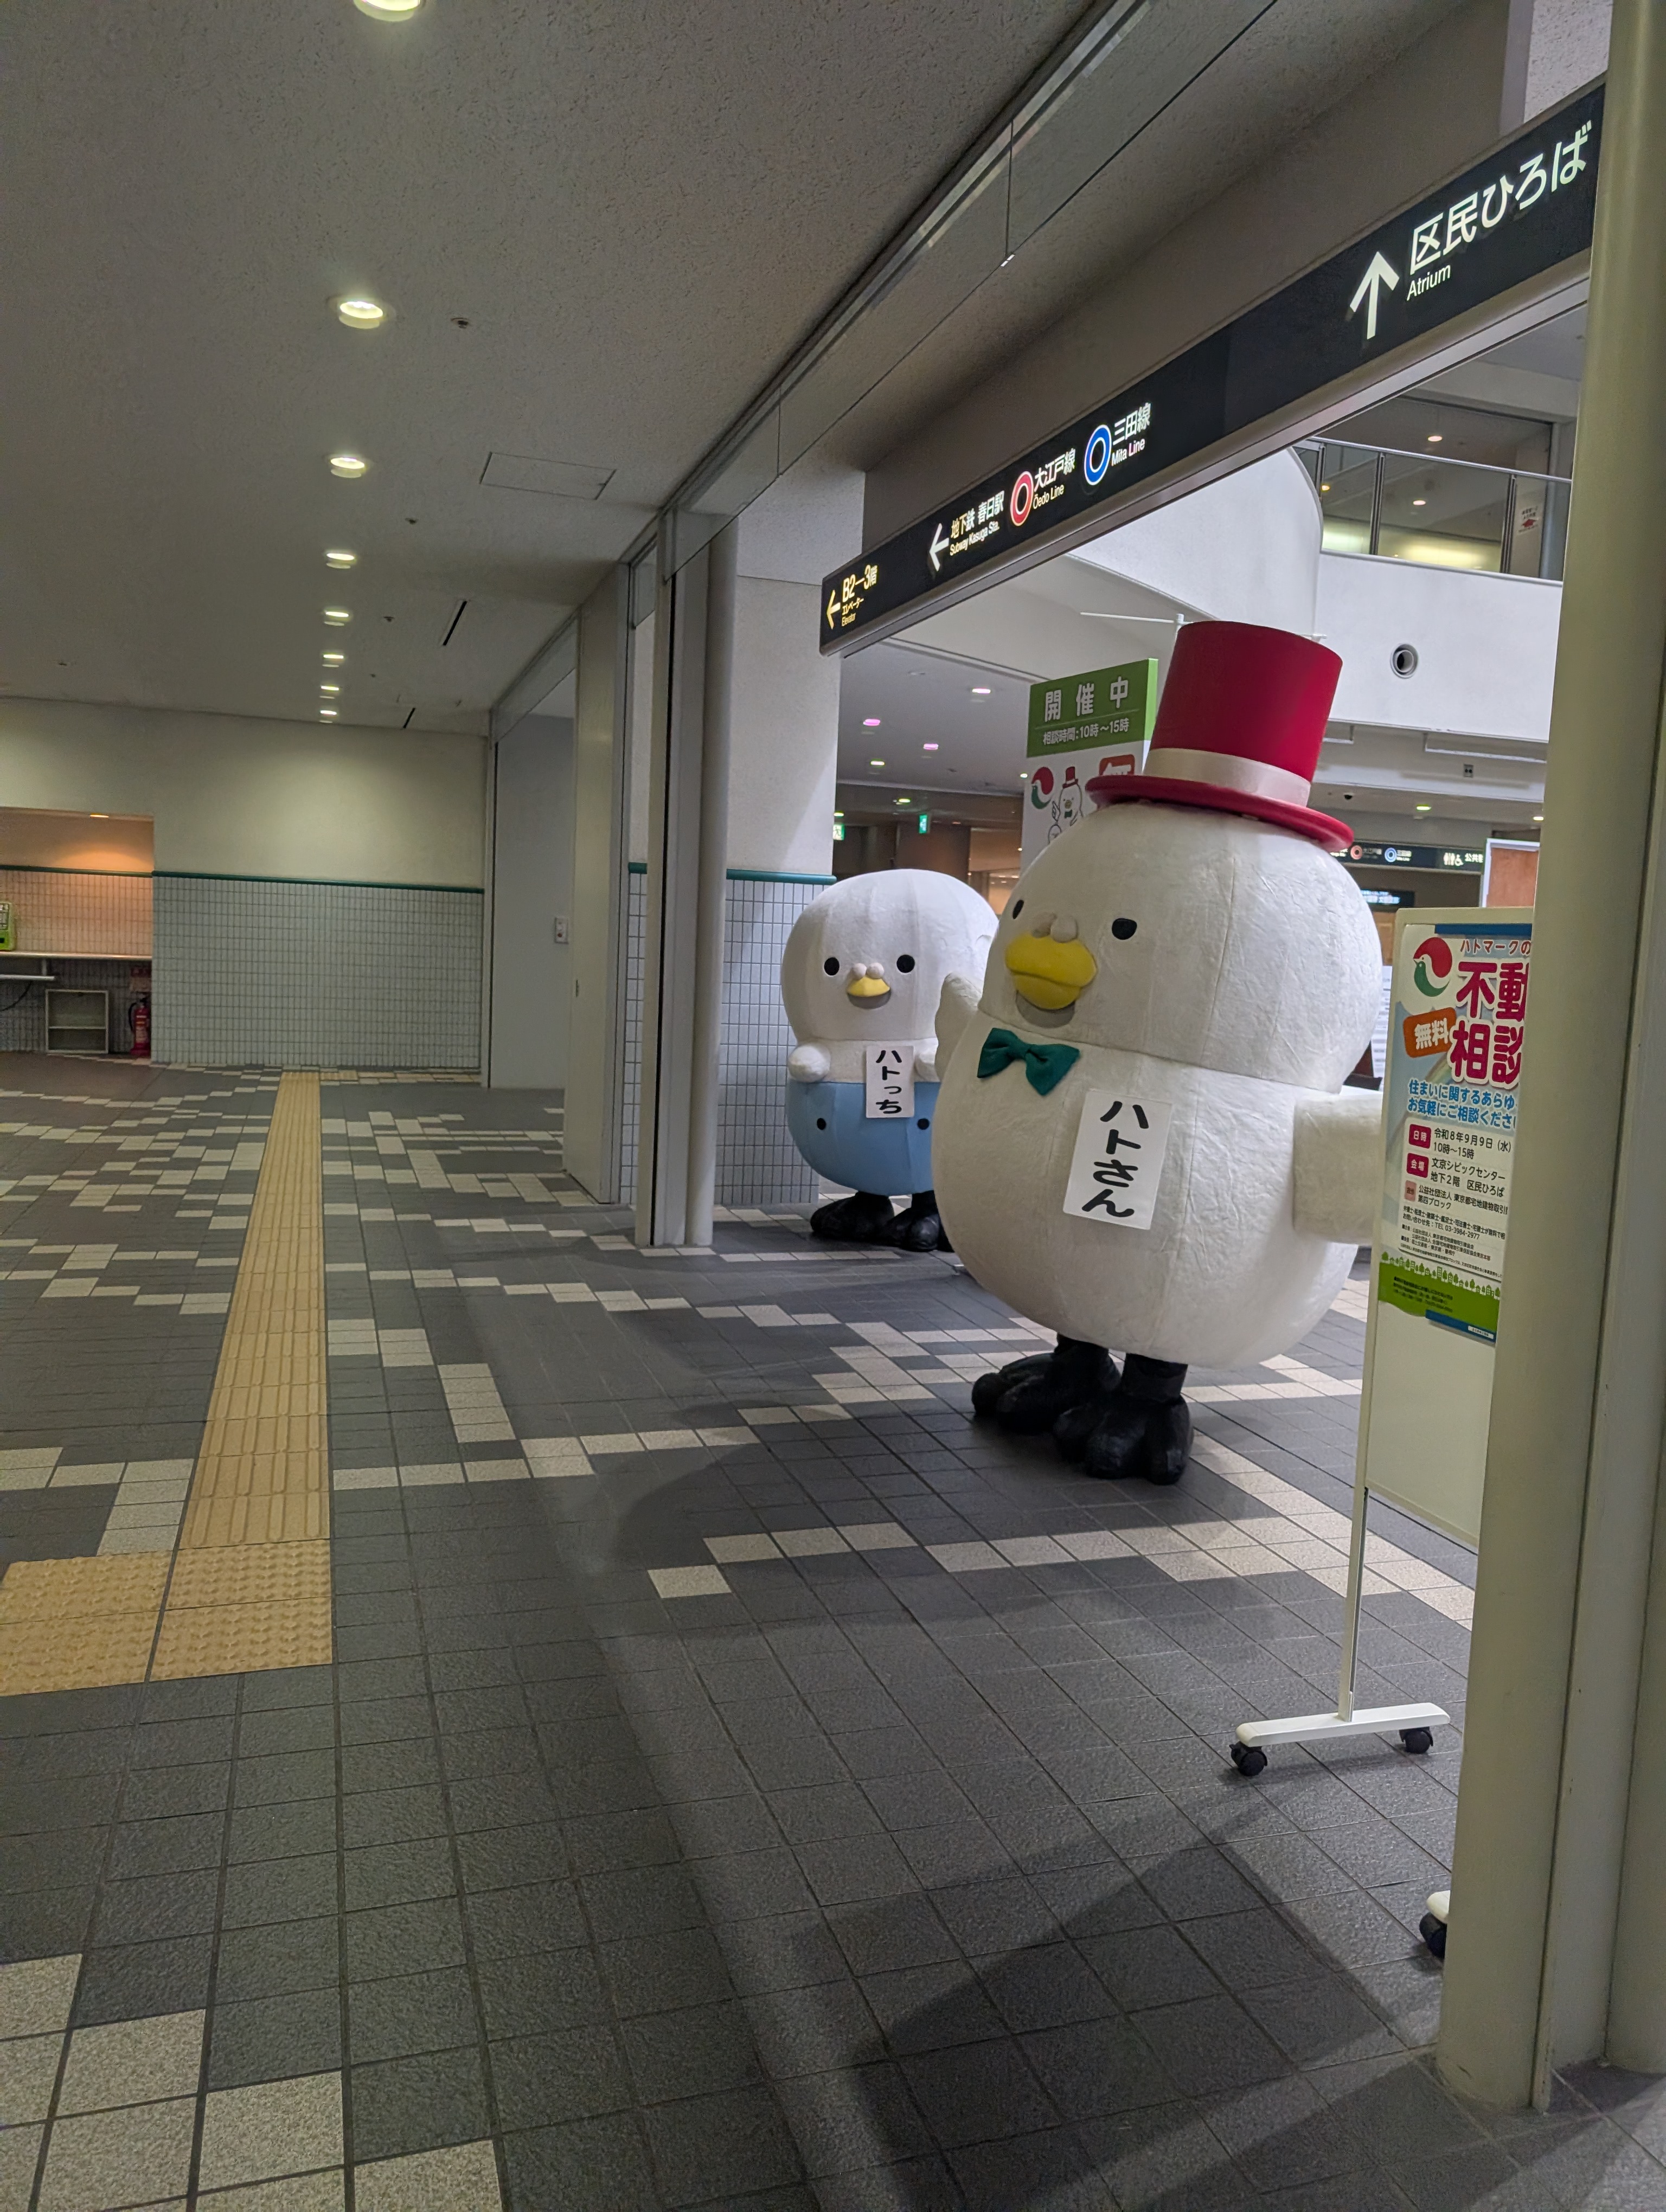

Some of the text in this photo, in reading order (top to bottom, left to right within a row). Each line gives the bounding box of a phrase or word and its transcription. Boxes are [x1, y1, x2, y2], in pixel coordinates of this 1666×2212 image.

[1410, 120, 1592, 275] 区民ひろば
[1406, 264, 1451, 301] Atrium
[1112, 402, 1151, 446] 三田線
[1111, 438, 1145, 467] Mita Line
[1034, 447, 1076, 492] 大江戸線
[1033, 484, 1065, 510] Ōedo Line
[950, 490, 1005, 539] 地下鉄 春日駅
[950, 538, 969, 556] Subway
[969, 526, 988, 545] Kasuga
[1044, 676, 1129, 723] 開催中
[1460, 938, 1532, 955] ハトマークの
[1456, 961, 1529, 1022] 不動
[1414, 1017, 1449, 1050] 無料
[1450, 1020, 1524, 1084] 相談
[875, 1050, 902, 1114] ハトっち
[1408, 1079, 1515, 1110] 住まいに関するあらゆ
[1413, 1130, 1427, 1142] 日時
[1433, 1142, 1475, 1160] 10時～15時
[1081, 1100, 1149, 1218] ハトさん
[1431, 1158, 1506, 1181] 文京シビックセンター
[1418, 1185, 1452, 1201] 公益社団法人
[1430, 1171, 1505, 1197] 地下2階 区民ひろば
[1417, 1194, 1452, 1210] 第四ブロック
[1445, 1225, 1480, 1240] 03-3984-2977
